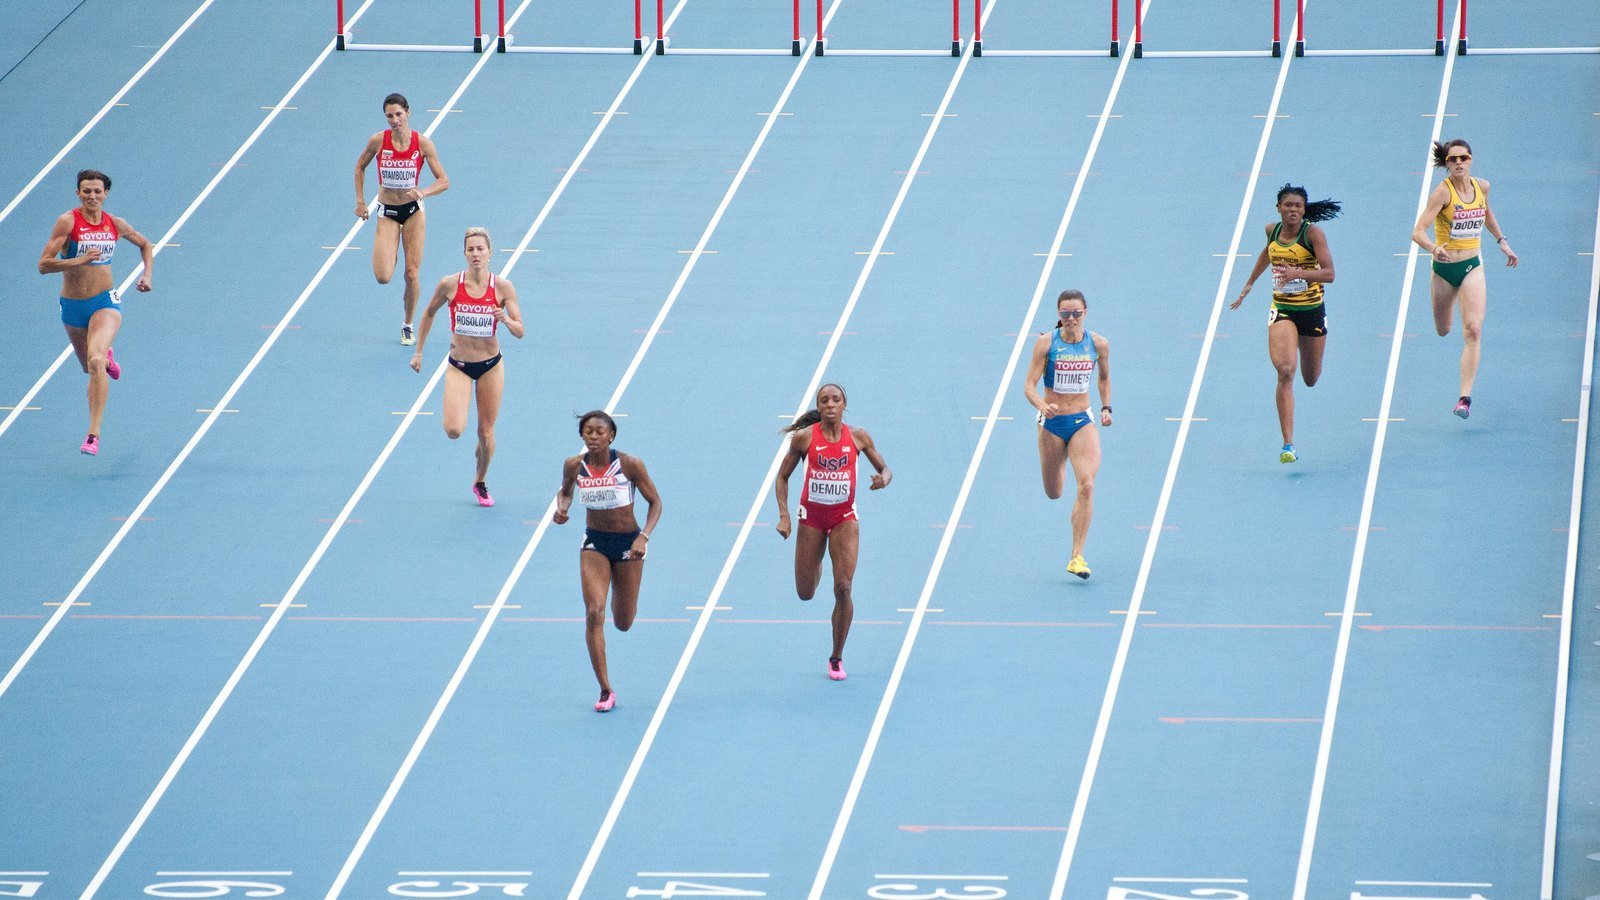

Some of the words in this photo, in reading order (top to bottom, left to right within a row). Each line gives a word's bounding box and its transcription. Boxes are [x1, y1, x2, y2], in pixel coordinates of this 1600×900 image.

[381, 170, 415, 181] STAMBOLOVA
[1454, 208, 1486, 219] TOYOTA
[78, 232, 114, 240] TOYOTA
[456, 304, 493, 313] TOYOTA
[1056, 361, 1093, 370] TOYOTA
[1056, 372, 1090, 385] TITIMETS
[817, 453, 849, 471] USA
[811, 469, 850, 480] TOYOTA
[579, 477, 614, 487] TOYOTA
[811, 482, 848, 496] DEMUS
